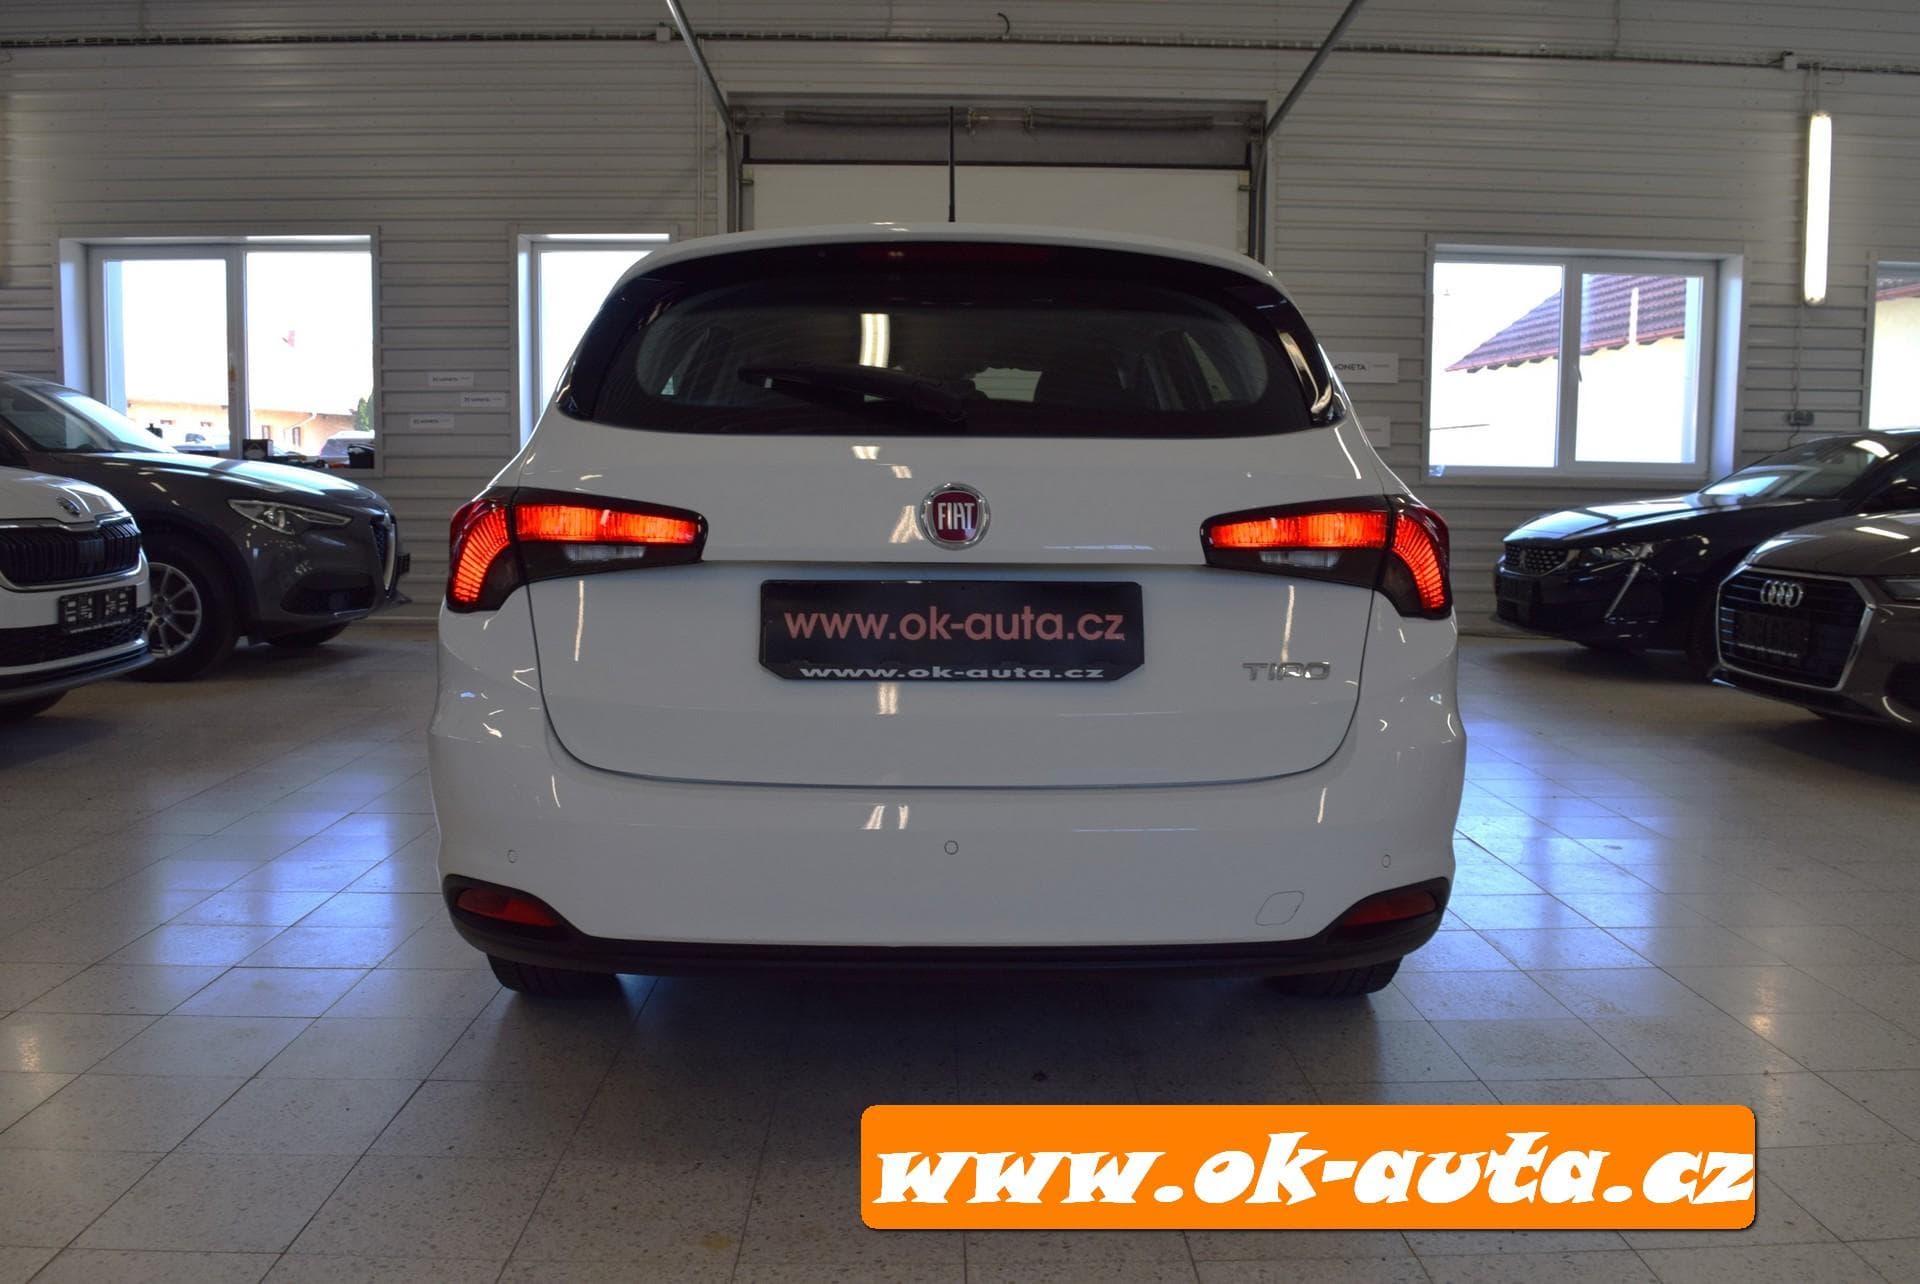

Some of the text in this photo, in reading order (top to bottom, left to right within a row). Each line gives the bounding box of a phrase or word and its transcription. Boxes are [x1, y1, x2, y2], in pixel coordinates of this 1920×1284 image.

[937, 502, 976, 531] FIAT
[784, 606, 1125, 641] www.ok-auta.cz
[799, 664, 1105, 679] www.ok-auta.cz
